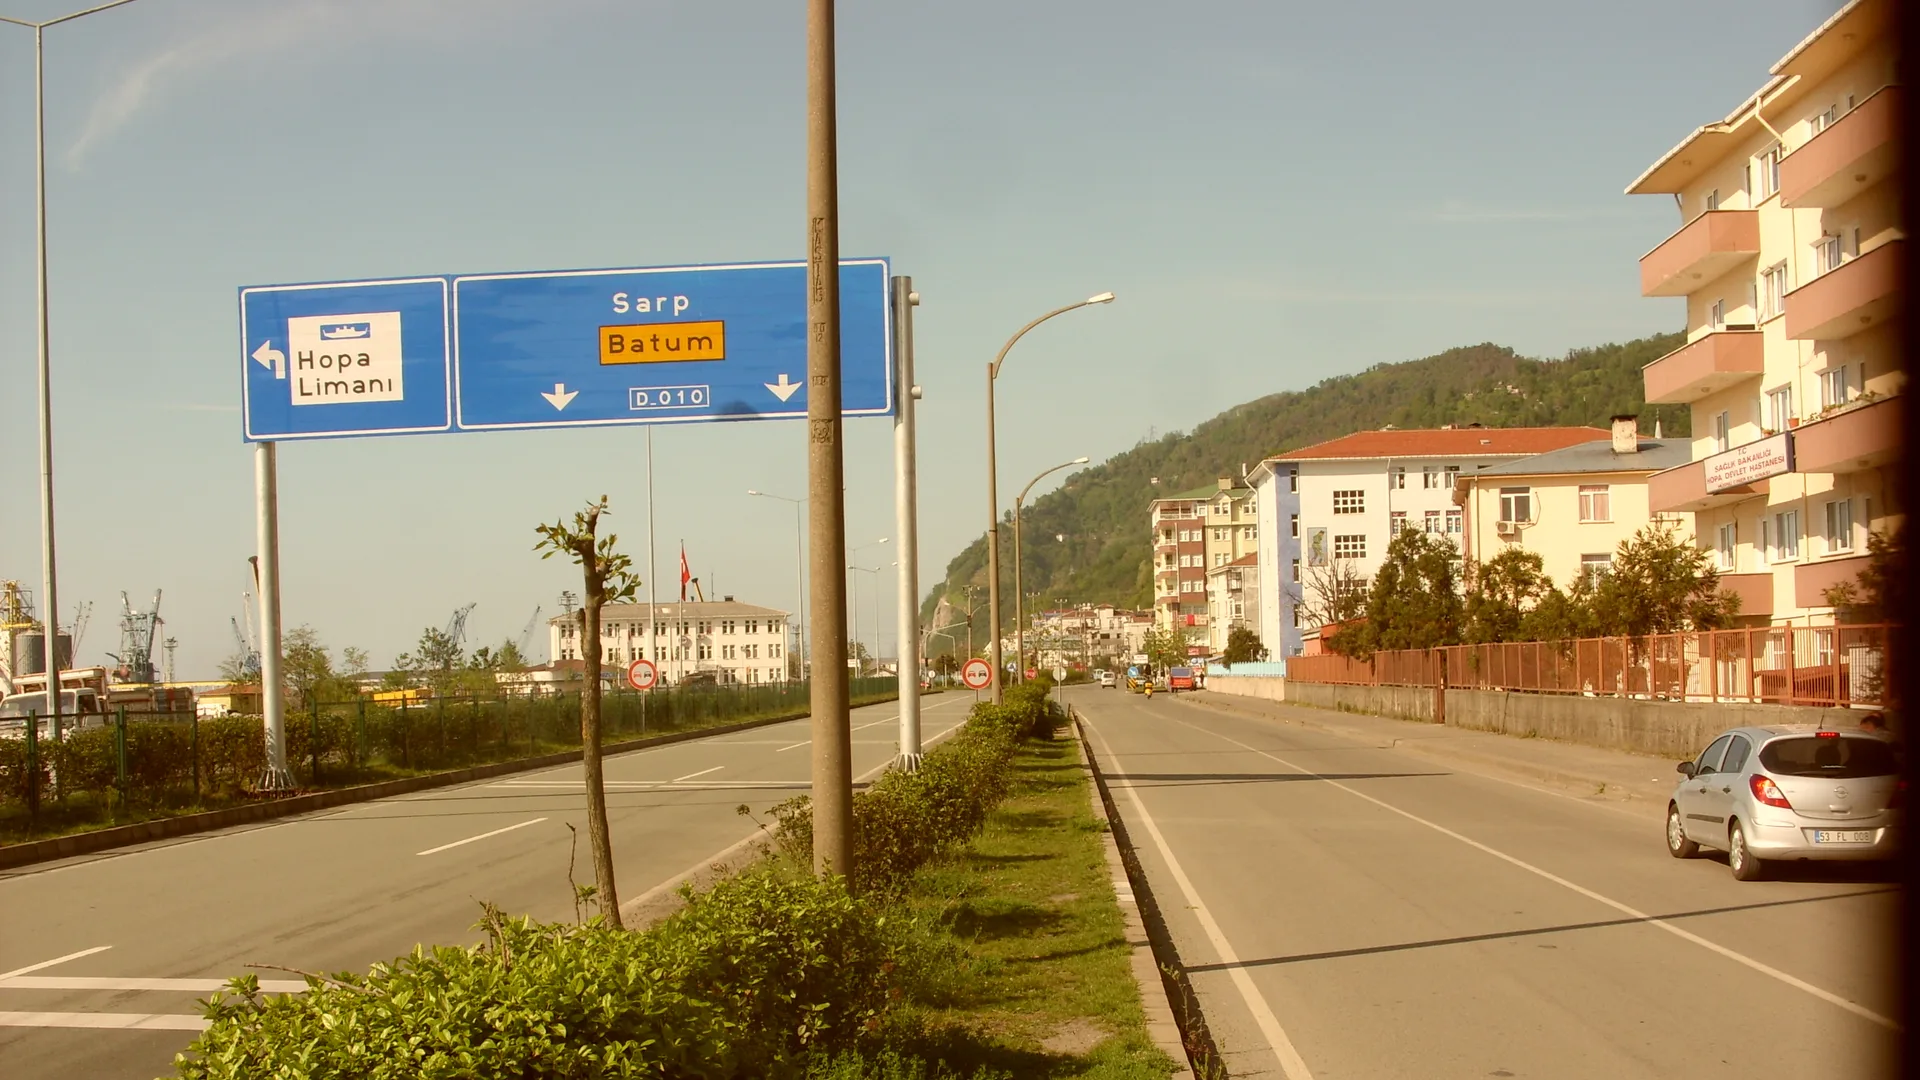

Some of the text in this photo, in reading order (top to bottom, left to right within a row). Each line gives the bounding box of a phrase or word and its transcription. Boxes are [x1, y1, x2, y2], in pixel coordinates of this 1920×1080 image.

[612, 291, 690, 317] Sarp
[608, 333, 713, 354] Batum
[298, 350, 370, 373] Hopa
[299, 377, 392, 396] Limanı
[1707, 474, 1722, 484] HOPA
[1725, 467, 1747, 479] DEVLET
[1820, 832, 1829, 841] 53
[1837, 832, 1847, 841] FL
